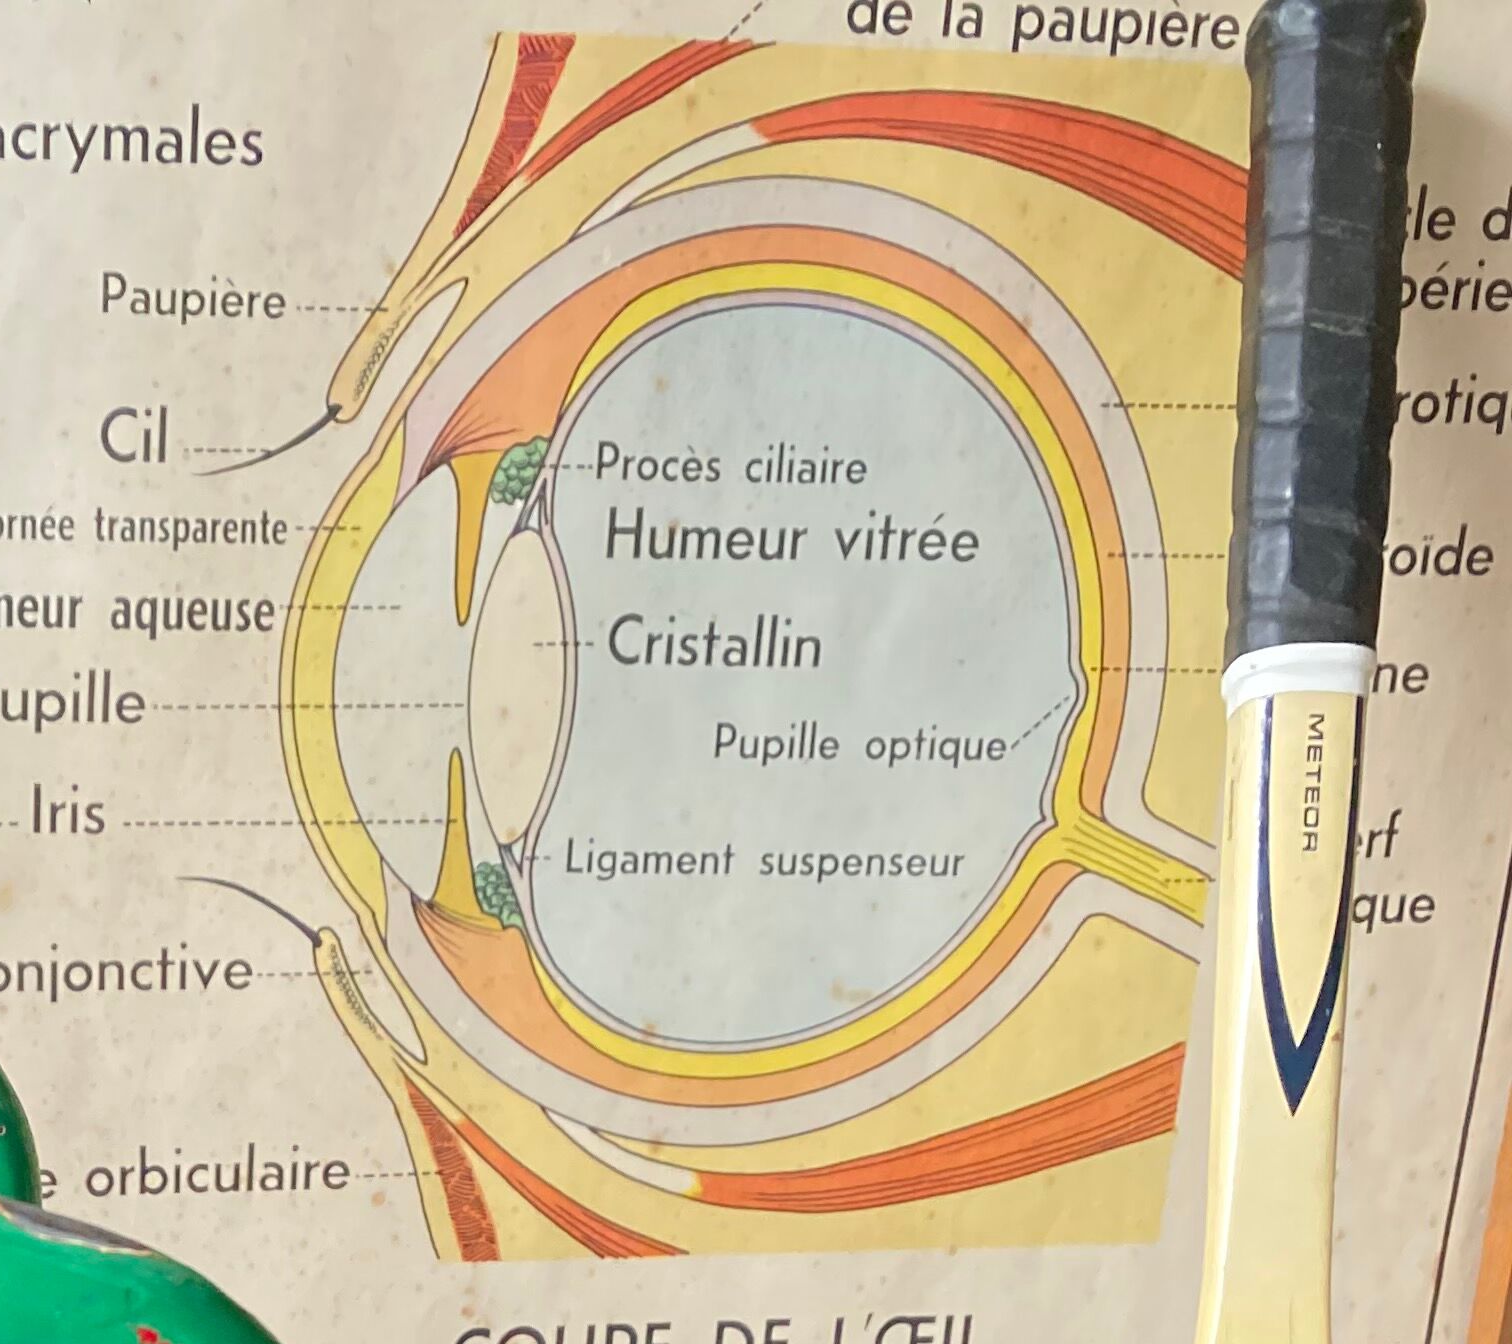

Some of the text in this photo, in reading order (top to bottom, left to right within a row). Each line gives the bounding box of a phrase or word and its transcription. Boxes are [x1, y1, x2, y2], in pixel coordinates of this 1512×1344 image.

[846, 0, 1240, 57] de la paupière
[102, 271, 287, 326] Paupière
[100, 404, 168, 464] Cil
[595, 440, 868, 485] Procès ciliaire
[94, 506, 288, 553] transparente
[605, 506, 980, 563] Humeur vitrée
[1383, 522, 1495, 577] oïde
[110, 596, 275, 641] aqueuse
[608, 612, 821, 668] Cristallin
[714, 719, 1007, 769] Pupille optique
[32, 782, 105, 836] Iris
[1301, 713, 1326, 853] METEOR
[566, 837, 965, 884] Ligament suspenseur
[85, 1142, 351, 1198] orbiculaire
